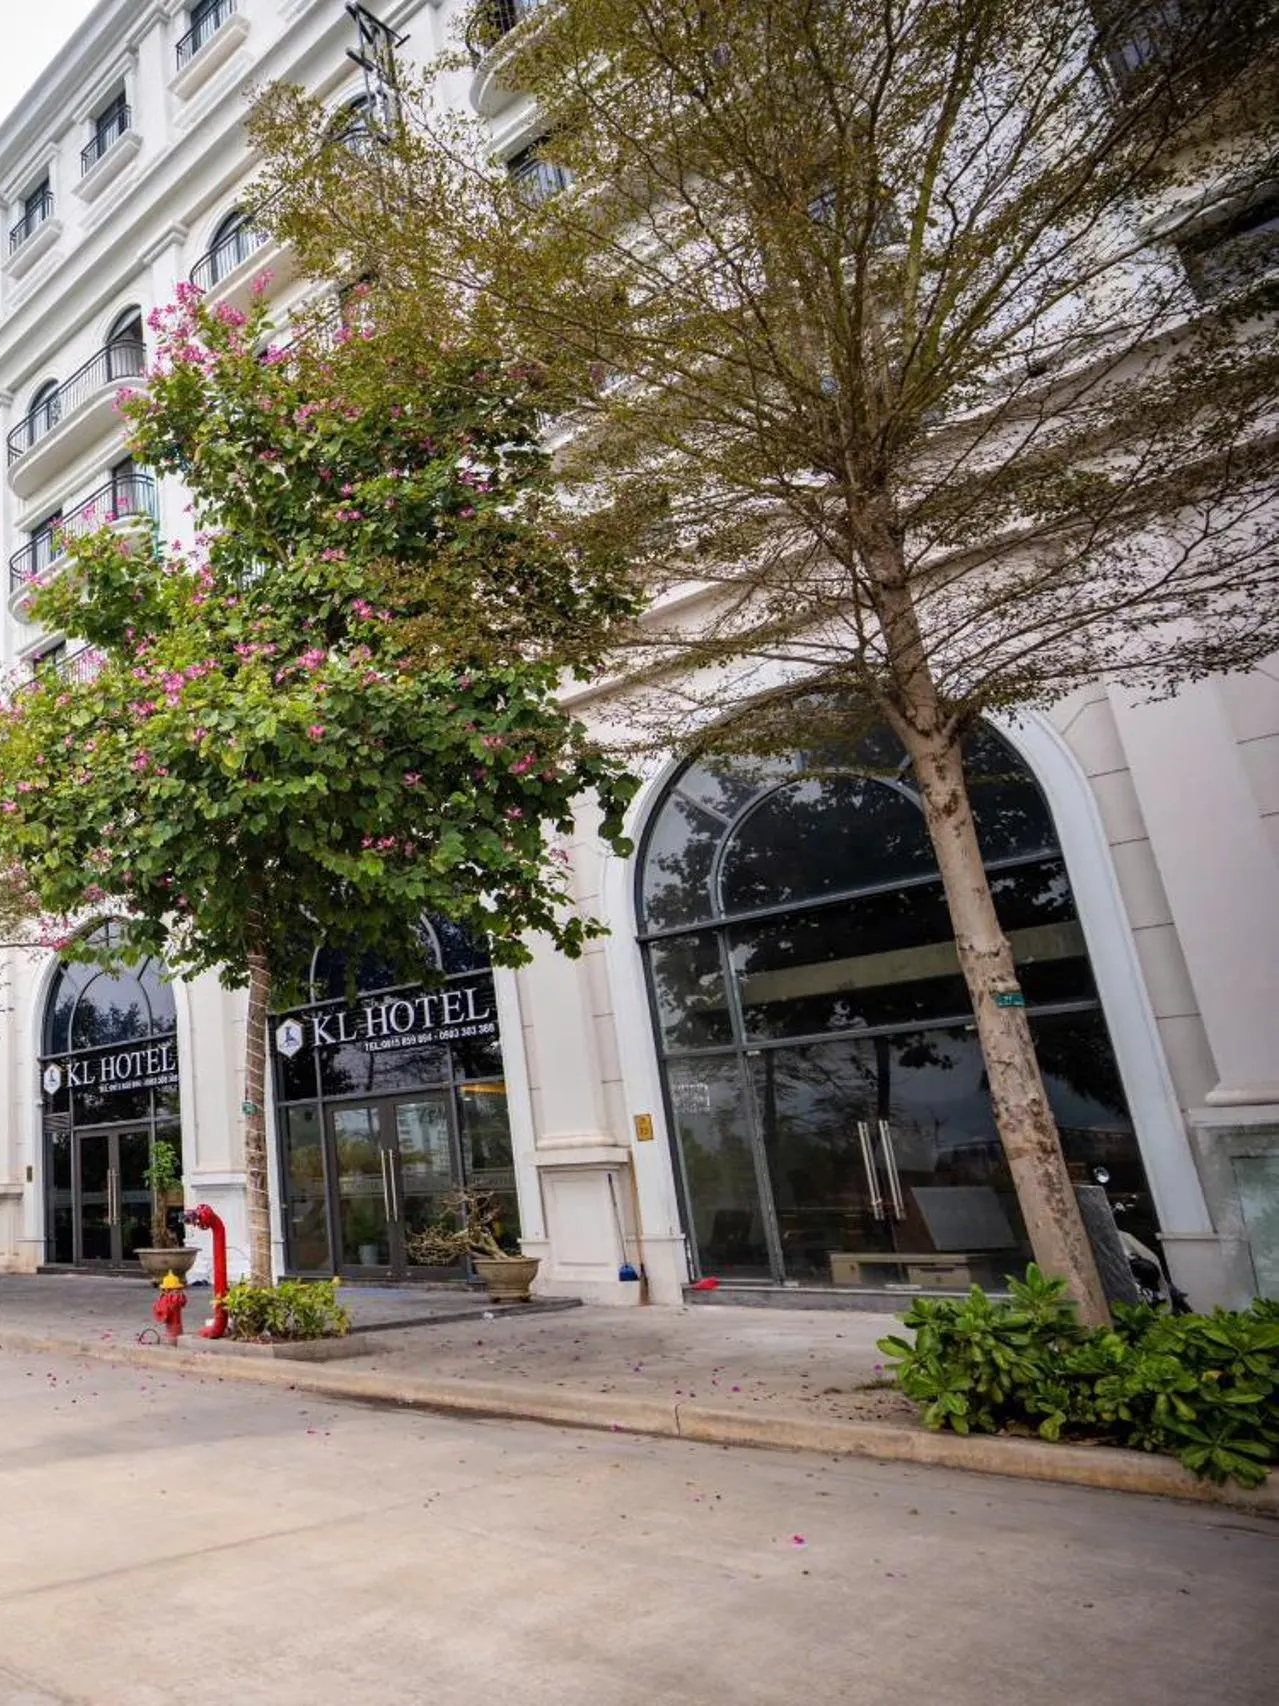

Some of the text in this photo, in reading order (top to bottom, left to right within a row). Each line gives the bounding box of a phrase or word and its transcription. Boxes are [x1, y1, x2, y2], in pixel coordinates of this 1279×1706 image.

[312, 987, 490, 1048] KL HOTEL
[66, 1060, 96, 1088] KL
[100, 1046, 176, 1082] HOTEL
